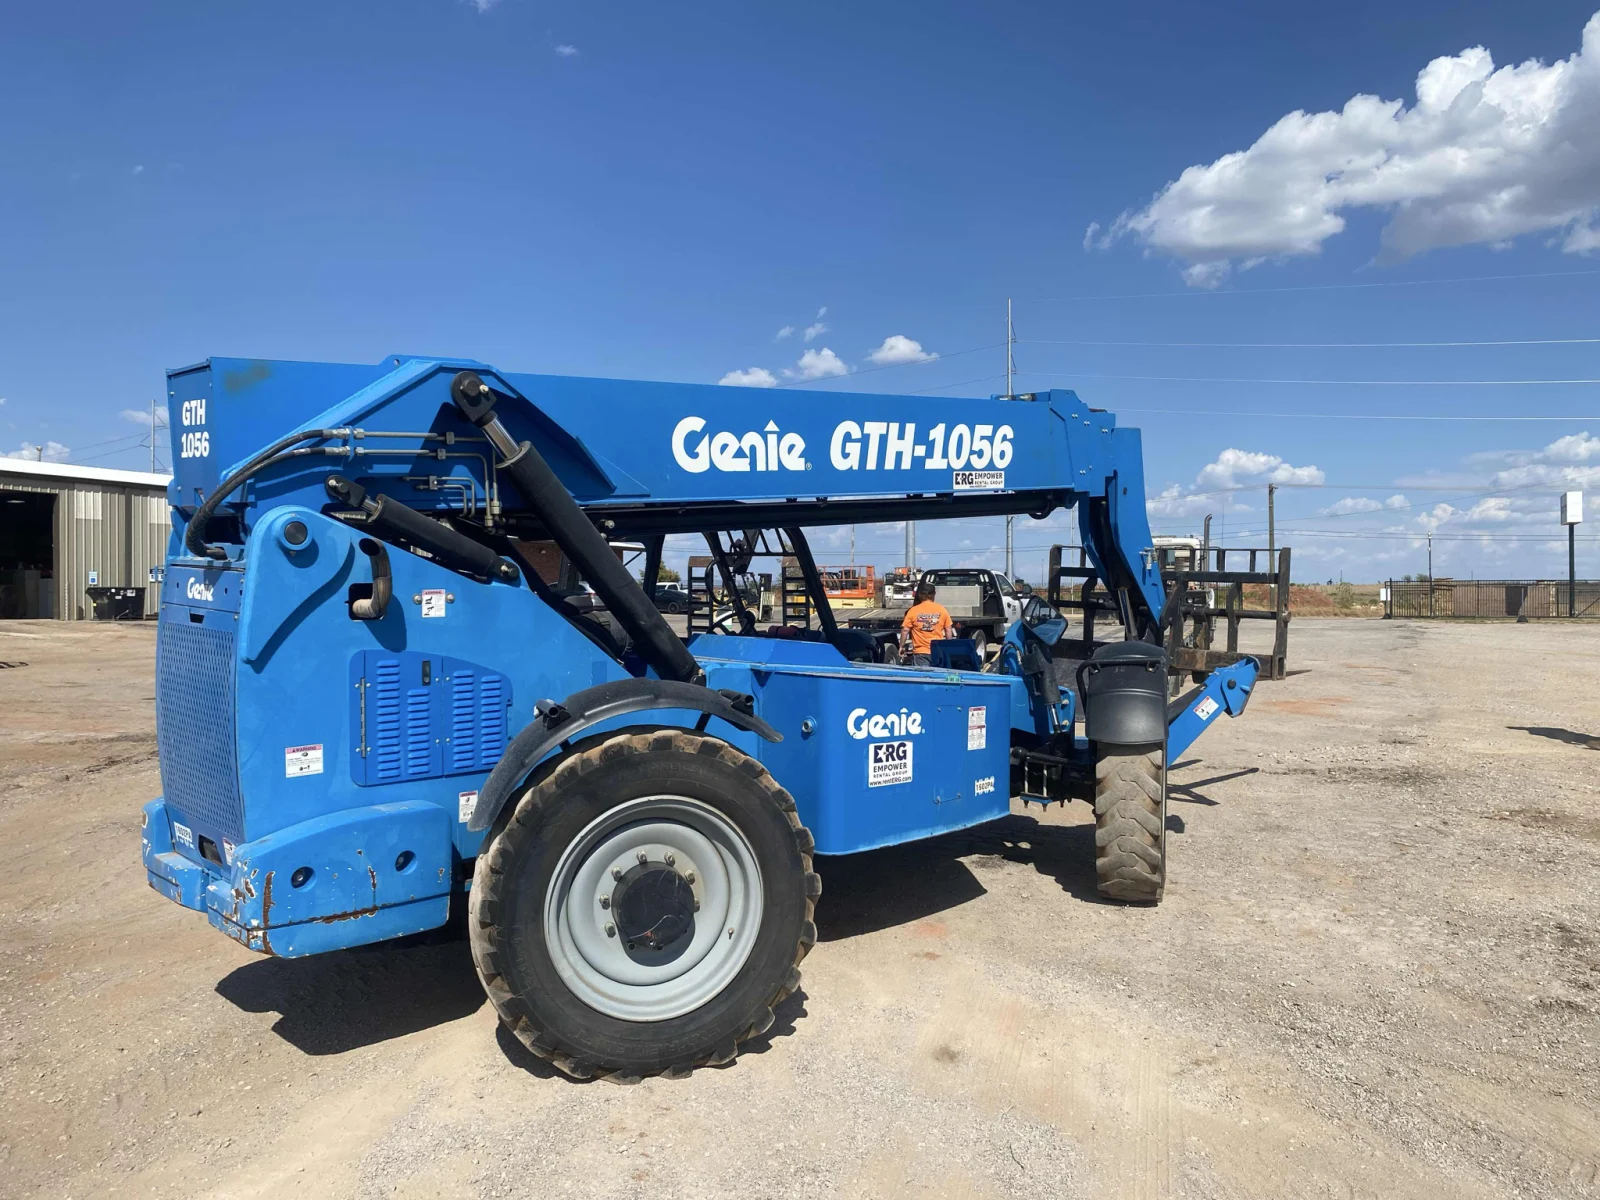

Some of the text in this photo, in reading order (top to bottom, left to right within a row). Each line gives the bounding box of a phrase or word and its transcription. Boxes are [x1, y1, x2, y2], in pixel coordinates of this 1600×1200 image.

[182, 399, 206, 426] GTH
[181, 431, 210, 459] 1056
[671, 416, 1014, 473] Genie GTH-1056
[955, 473, 974, 485] ERG
[847, 707, 922, 740] Genie
[873, 742, 908, 764] ERG
[873, 762, 908, 773] EMPOWER
[891, 769, 908, 777] GROUP
